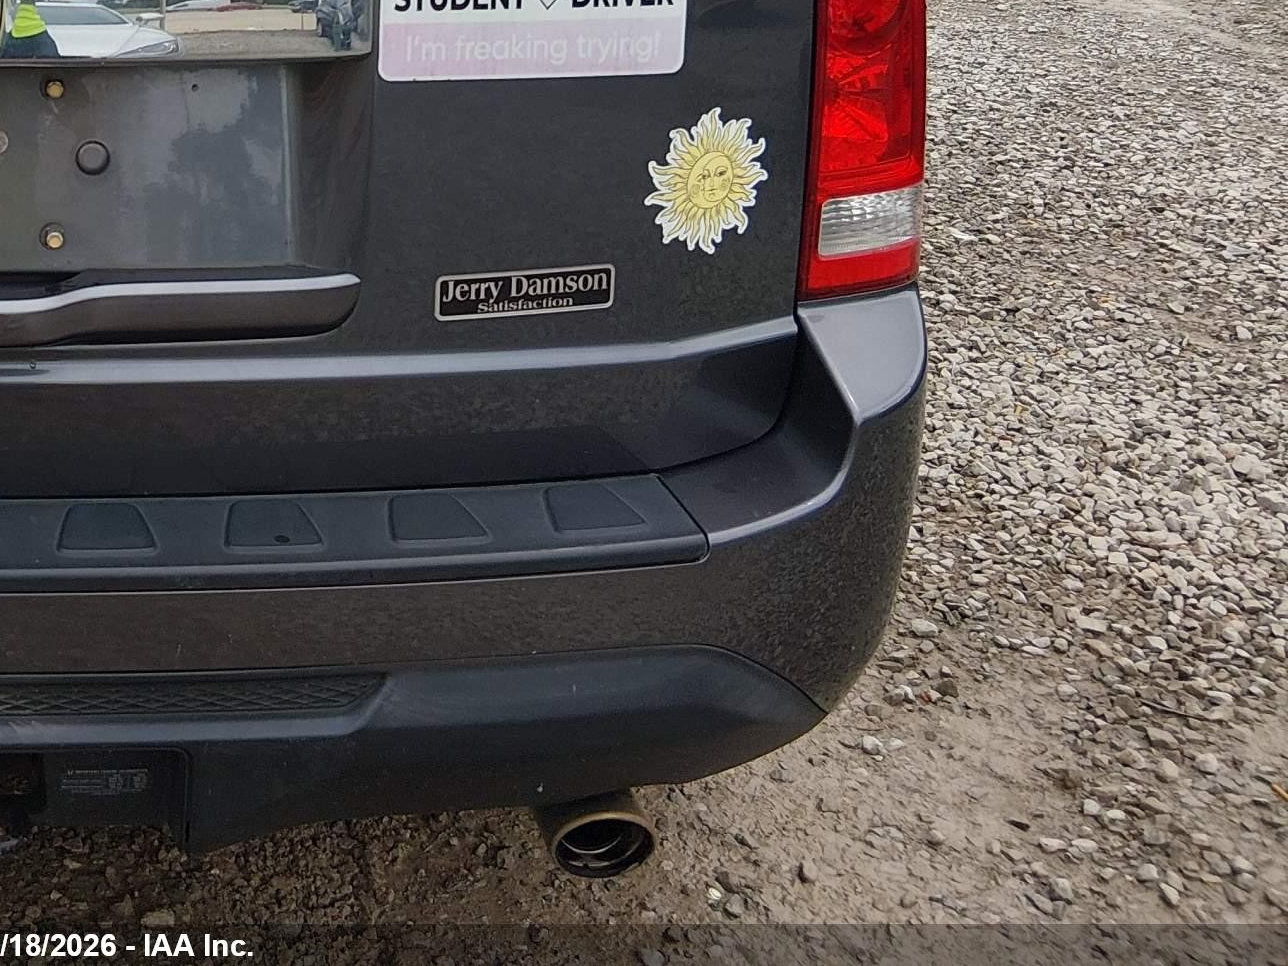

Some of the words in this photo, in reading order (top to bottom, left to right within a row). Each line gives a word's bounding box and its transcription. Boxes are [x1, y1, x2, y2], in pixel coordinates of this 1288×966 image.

[454, 34, 568, 64] freaking
[576, 31, 660, 64] trying!
[443, 281, 503, 303] Jerry
[510, 272, 608, 297] Damson
[477, 297, 574, 313] Satisfaction
